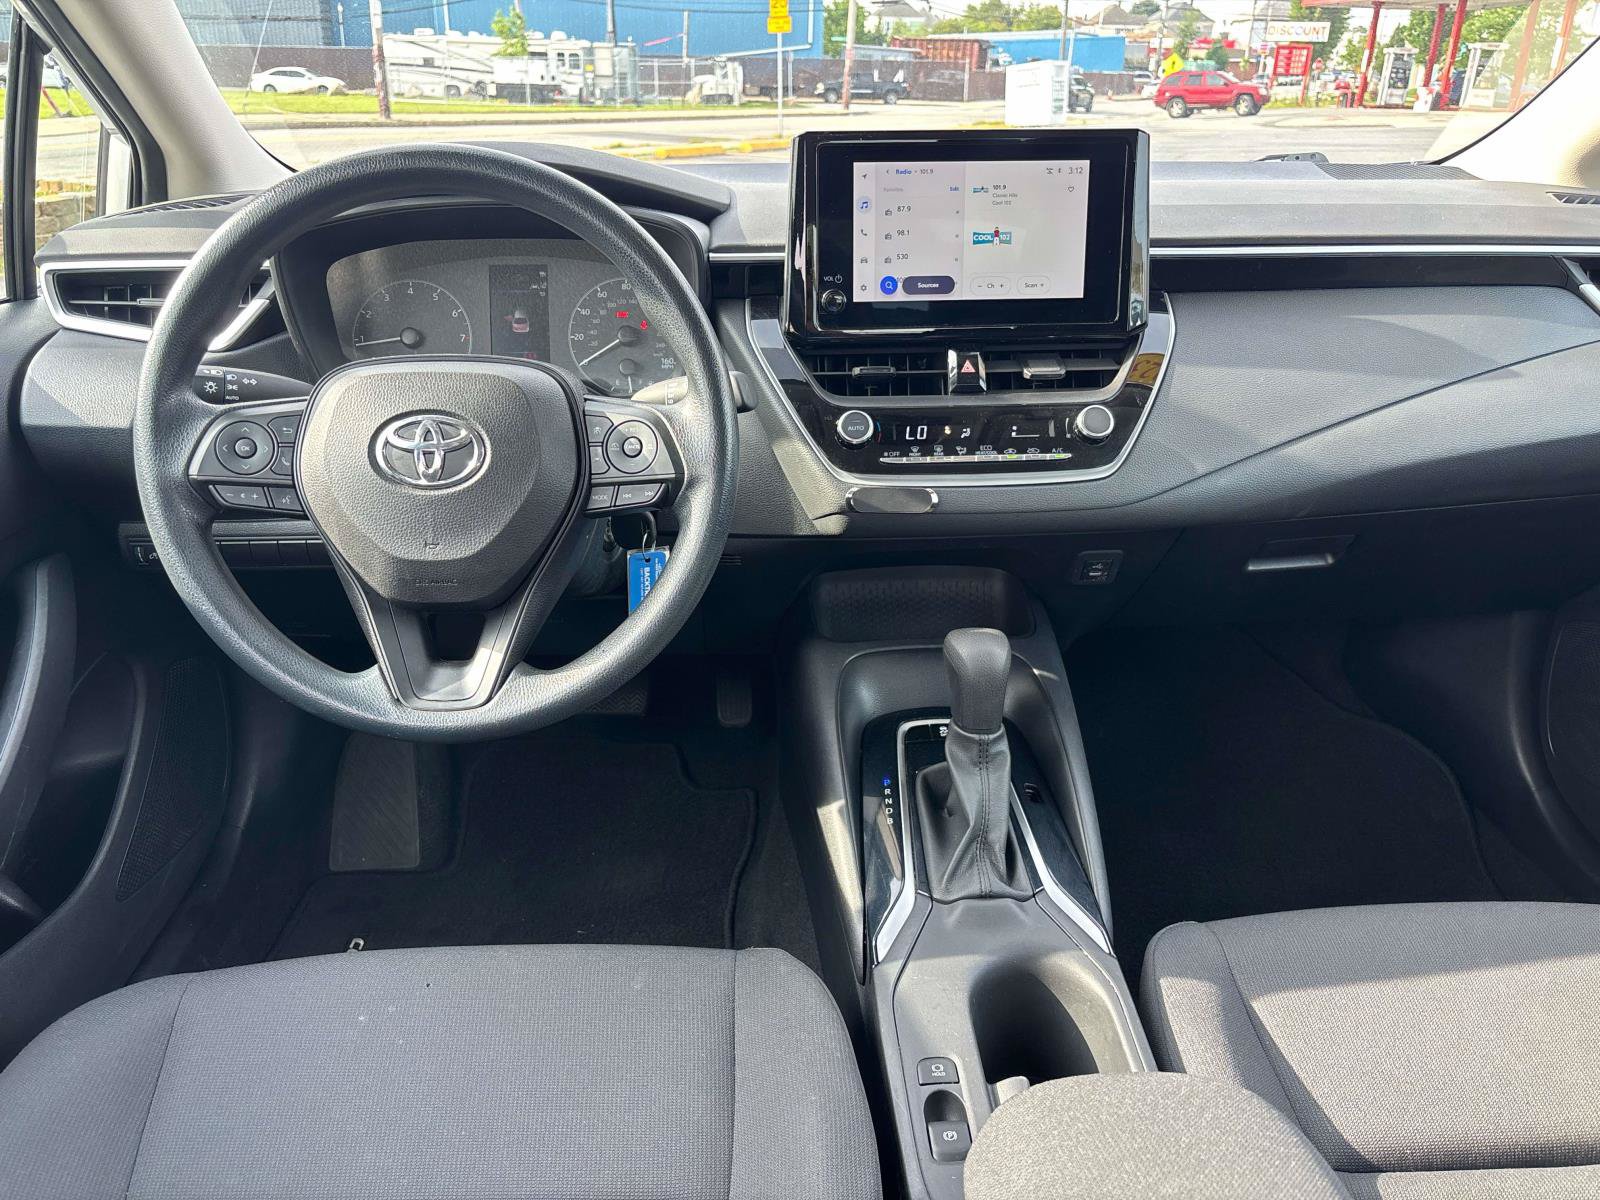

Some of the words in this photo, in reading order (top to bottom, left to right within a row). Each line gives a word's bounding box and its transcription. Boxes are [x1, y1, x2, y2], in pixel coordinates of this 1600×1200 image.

[1267, 25, 1328, 36] DISCOUNT
[1068, 166, 1084, 174] 3:12
[432, 292, 439, 301] 5
[366, 310, 372, 318] 2
[452, 309, 458, 318] 6
[460, 334, 466, 342] 7
[574, 333, 585, 341] 20
[905, 425, 928, 440] LO
[887, 817, 894, 825] B
